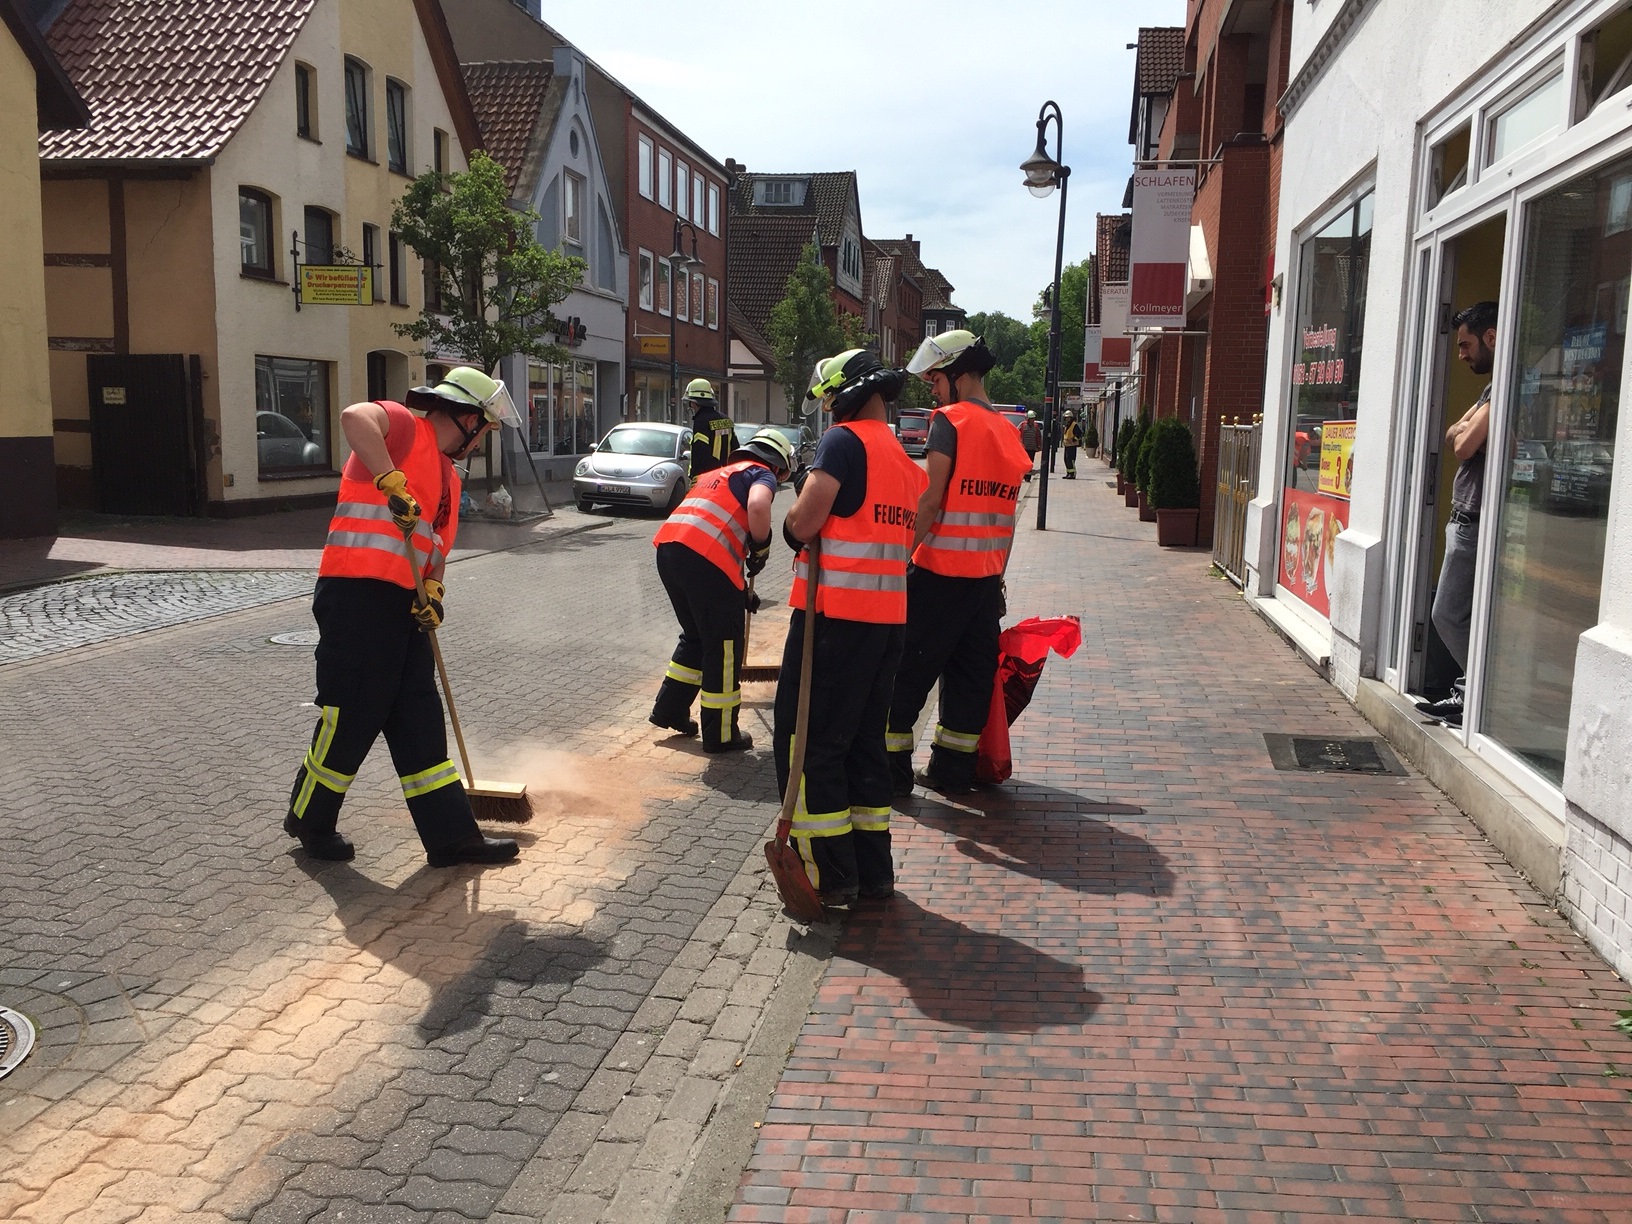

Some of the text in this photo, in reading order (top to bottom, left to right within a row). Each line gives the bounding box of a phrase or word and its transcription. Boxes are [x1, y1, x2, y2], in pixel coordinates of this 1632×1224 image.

[1135, 176, 1194, 187] SCHLAFEN
[1132, 303, 1182, 314] Kollmeyer
[1101, 360, 1131, 368] Kollmeyer
[1335, 456, 1342, 490] 3
